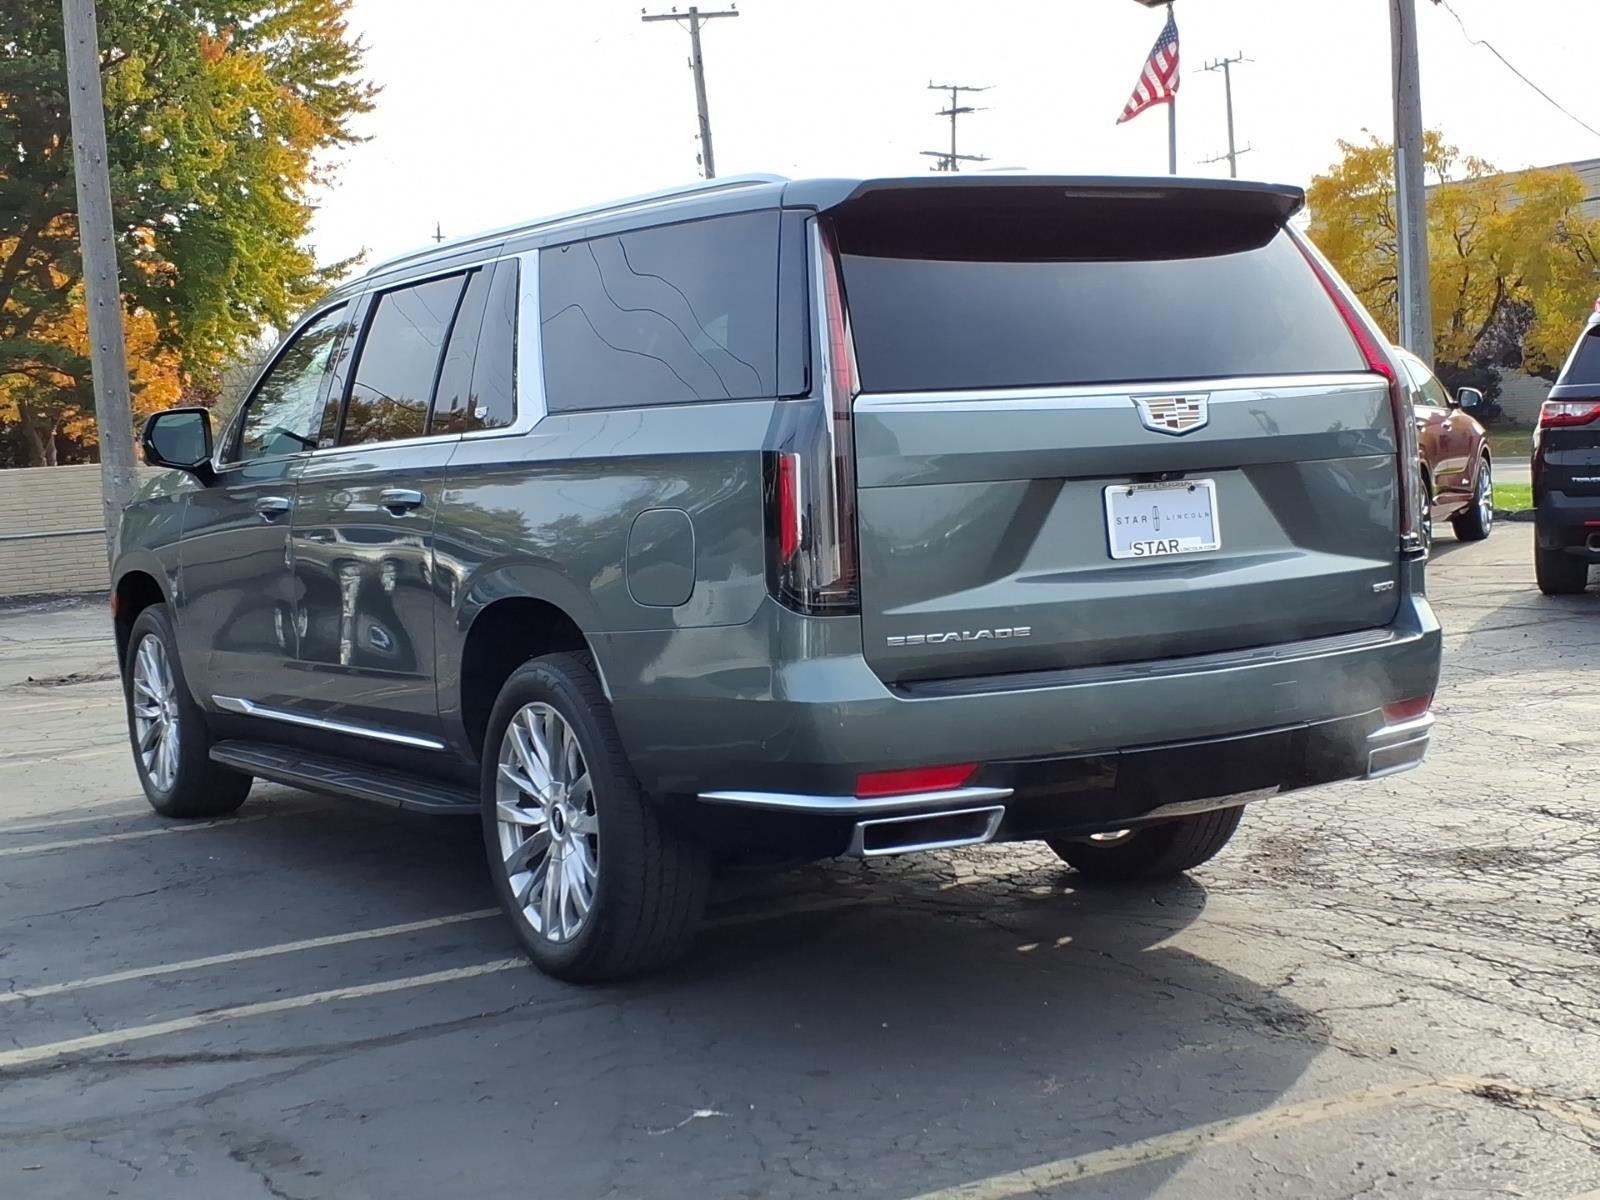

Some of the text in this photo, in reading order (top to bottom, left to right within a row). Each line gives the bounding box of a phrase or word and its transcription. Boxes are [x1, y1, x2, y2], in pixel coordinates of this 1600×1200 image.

[1116, 512, 1209, 525] STAR LINCOLN
[1133, 539, 1180, 556] STAR
[886, 626, 1032, 647] ESCALADE
